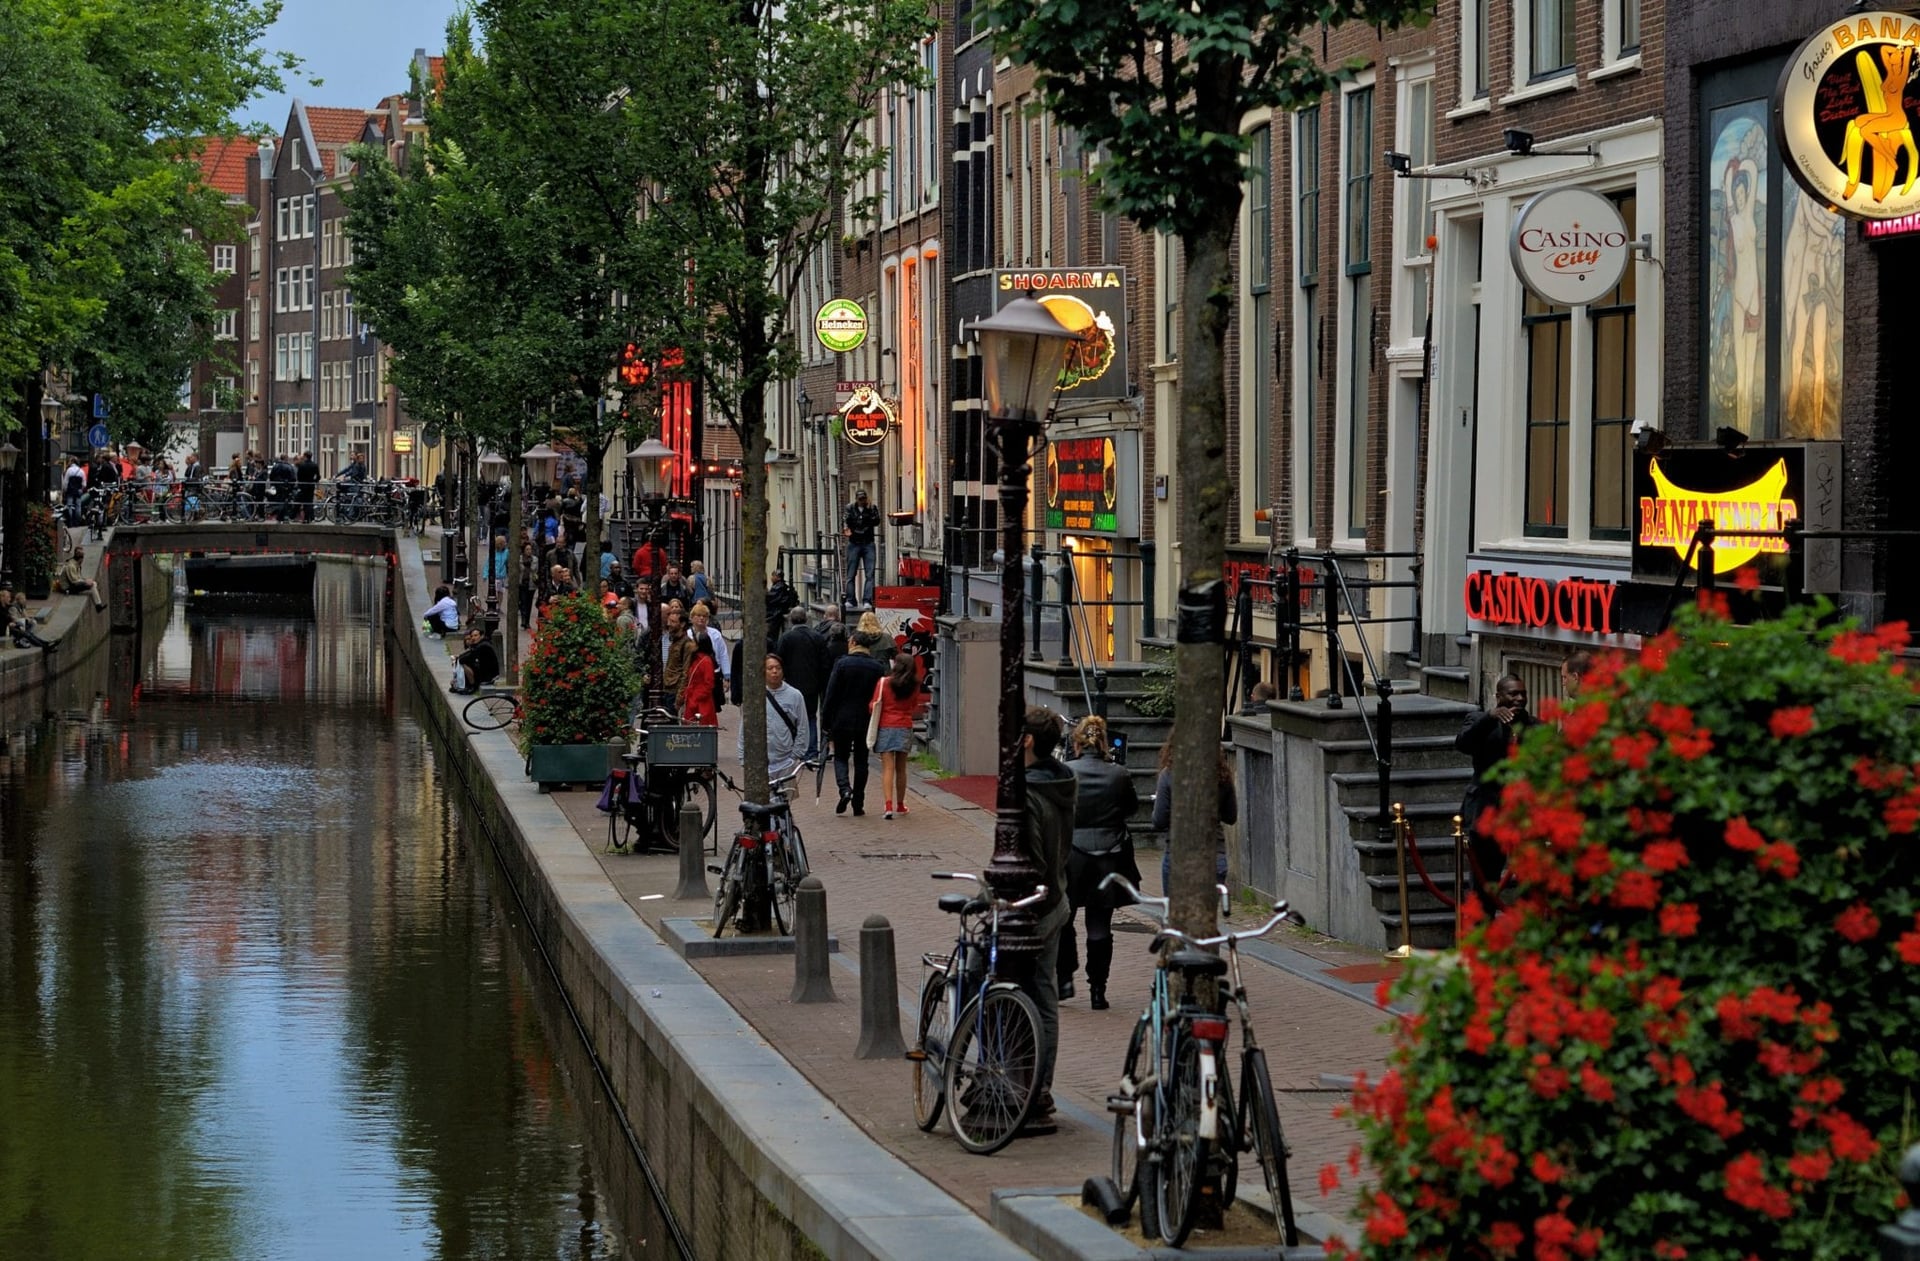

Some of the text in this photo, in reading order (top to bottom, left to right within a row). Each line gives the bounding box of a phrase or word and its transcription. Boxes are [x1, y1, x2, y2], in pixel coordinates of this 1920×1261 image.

[1804, 40, 1834, 82] Going
[1839, 83, 1860, 95] Red
[1519, 222, 1626, 252] CASINO
[1553, 249, 1601, 268] City
[1000, 271, 1120, 290] SHOARMA
[821, 320, 864, 329] Heineken
[836, 382, 877, 391] TE KOO
[857, 420, 877, 429] BAR
[1464, 571, 1616, 634] CASINO CITY
